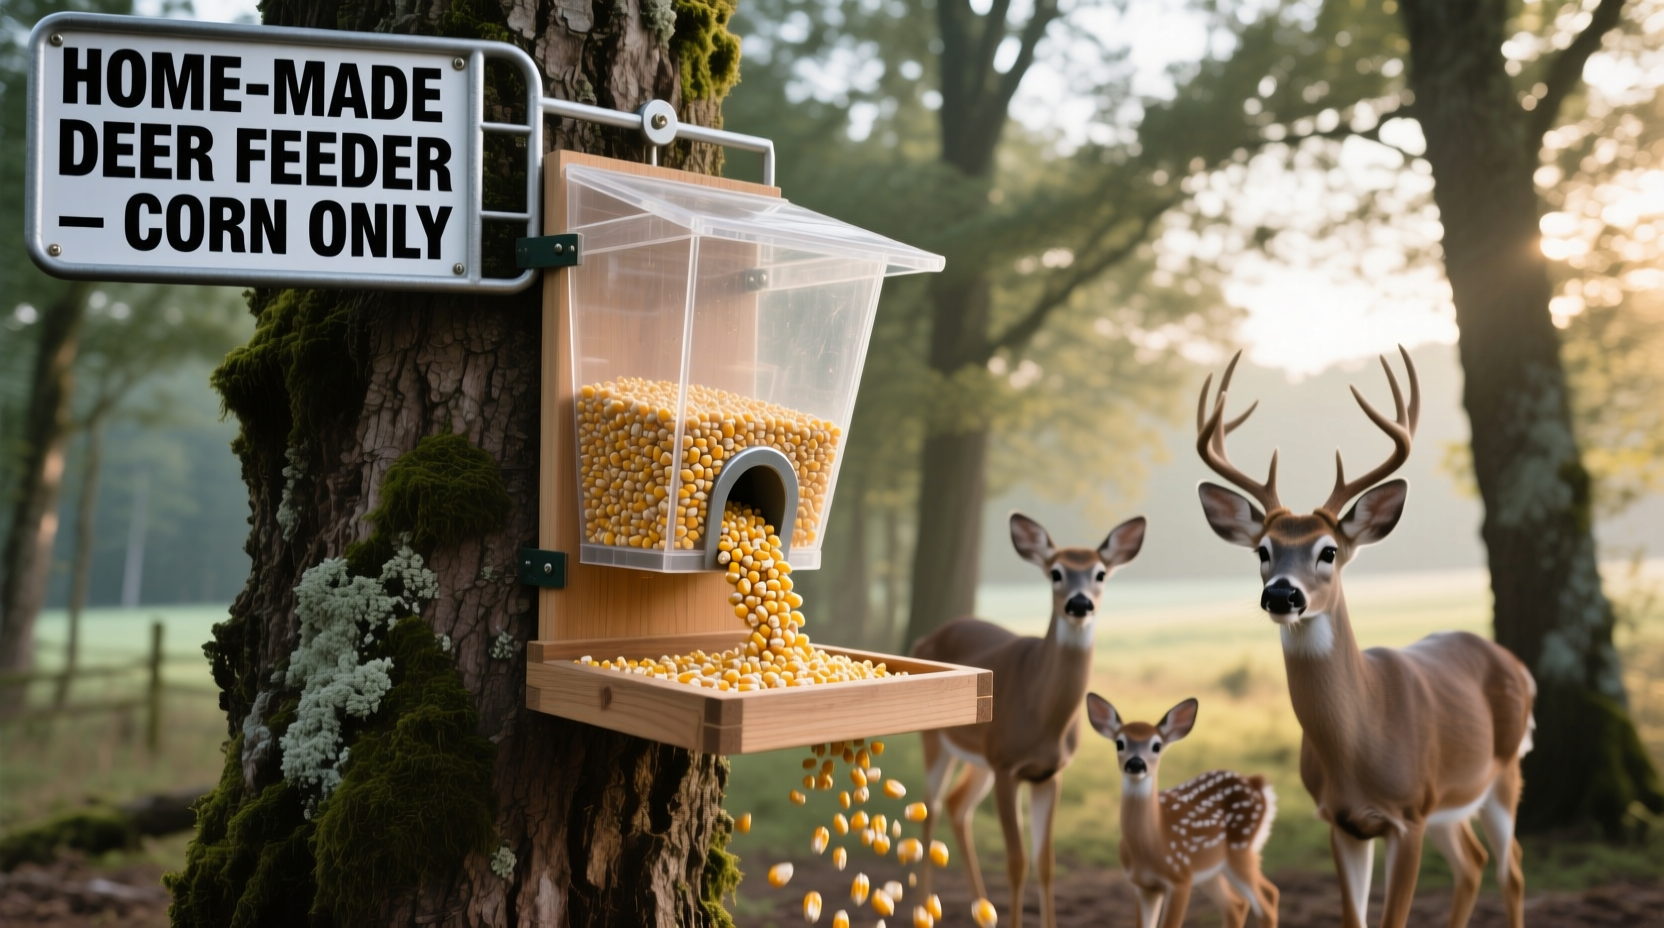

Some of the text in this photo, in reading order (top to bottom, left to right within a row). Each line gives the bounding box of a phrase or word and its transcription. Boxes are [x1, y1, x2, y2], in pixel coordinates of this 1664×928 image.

[62, 46, 443, 123] HOME-MADE
[58, 118, 453, 192] DEER FEEDER
[124, 192, 287, 255] CORN
[308, 199, 453, 260] ONLY
